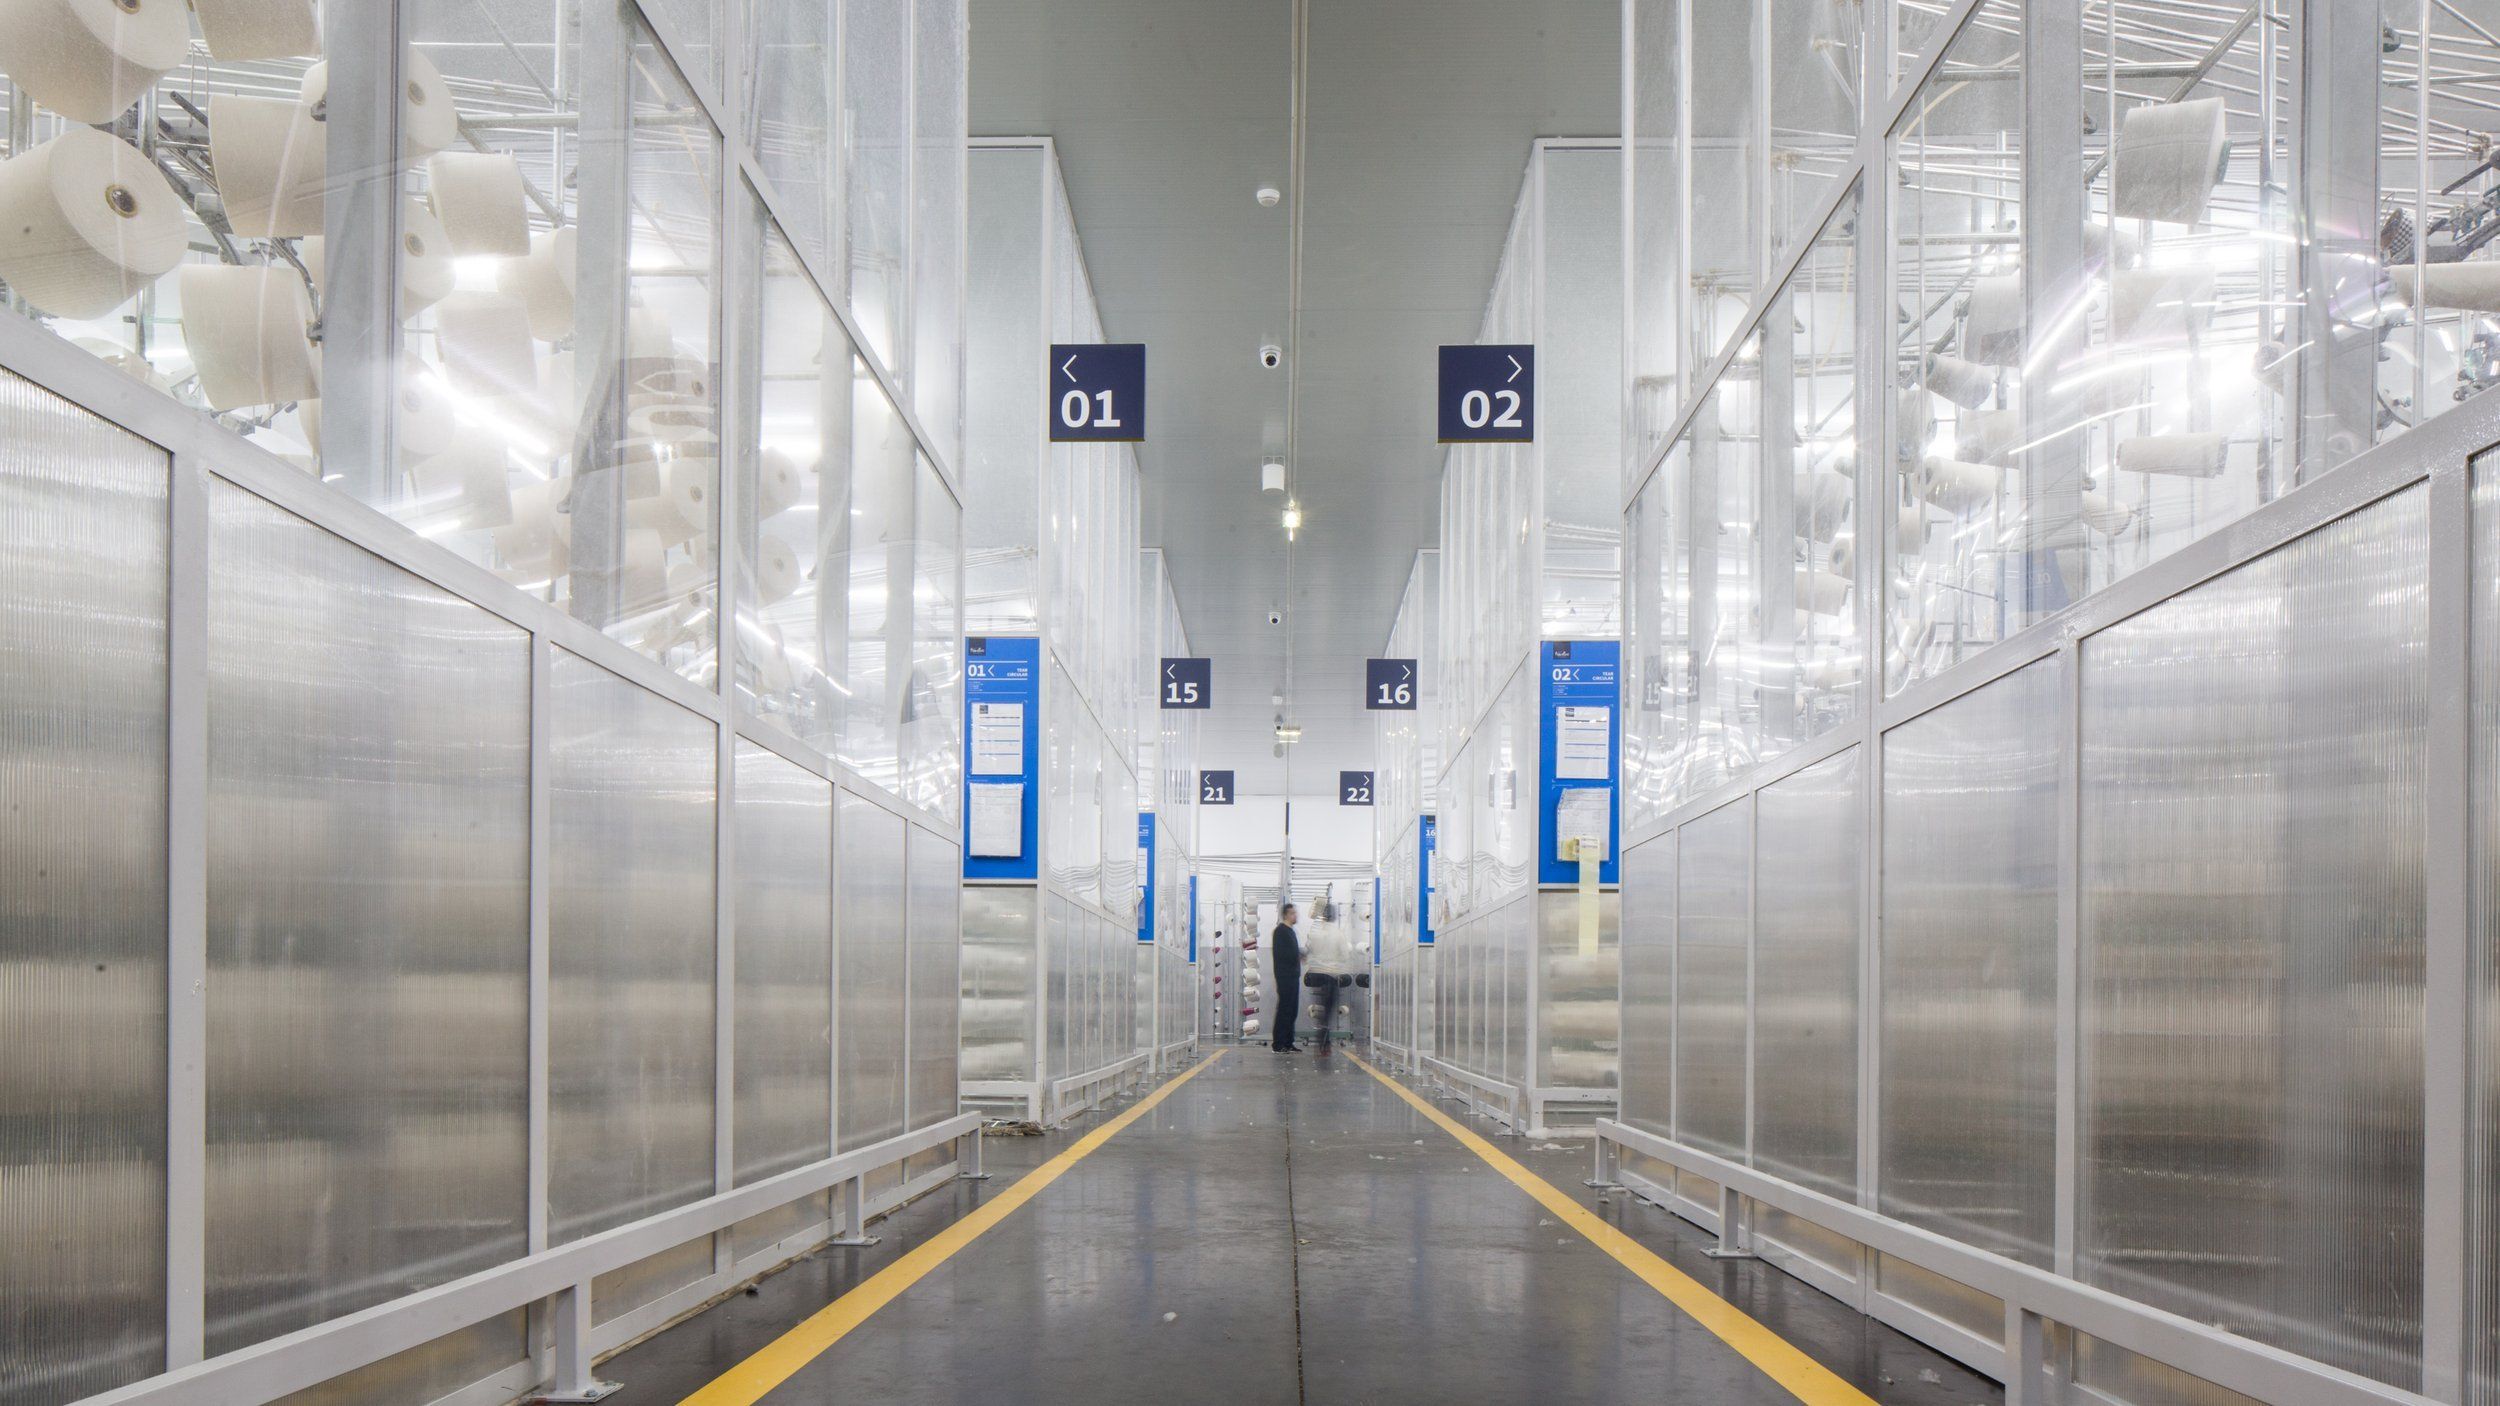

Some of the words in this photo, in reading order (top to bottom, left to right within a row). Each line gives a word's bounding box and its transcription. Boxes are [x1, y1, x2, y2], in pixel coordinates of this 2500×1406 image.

[1061, 390, 1121, 428] 01
[1461, 390, 1522, 428] 02
[968, 664, 986, 677] 01
[1552, 668, 1571, 681] 02
[1167, 682, 1197, 703] 15
[1378, 683, 1410, 704] 16
[1204, 787, 1226, 801] 21
[1347, 787, 1370, 802] 22
[1425, 829, 1435, 837] 16
